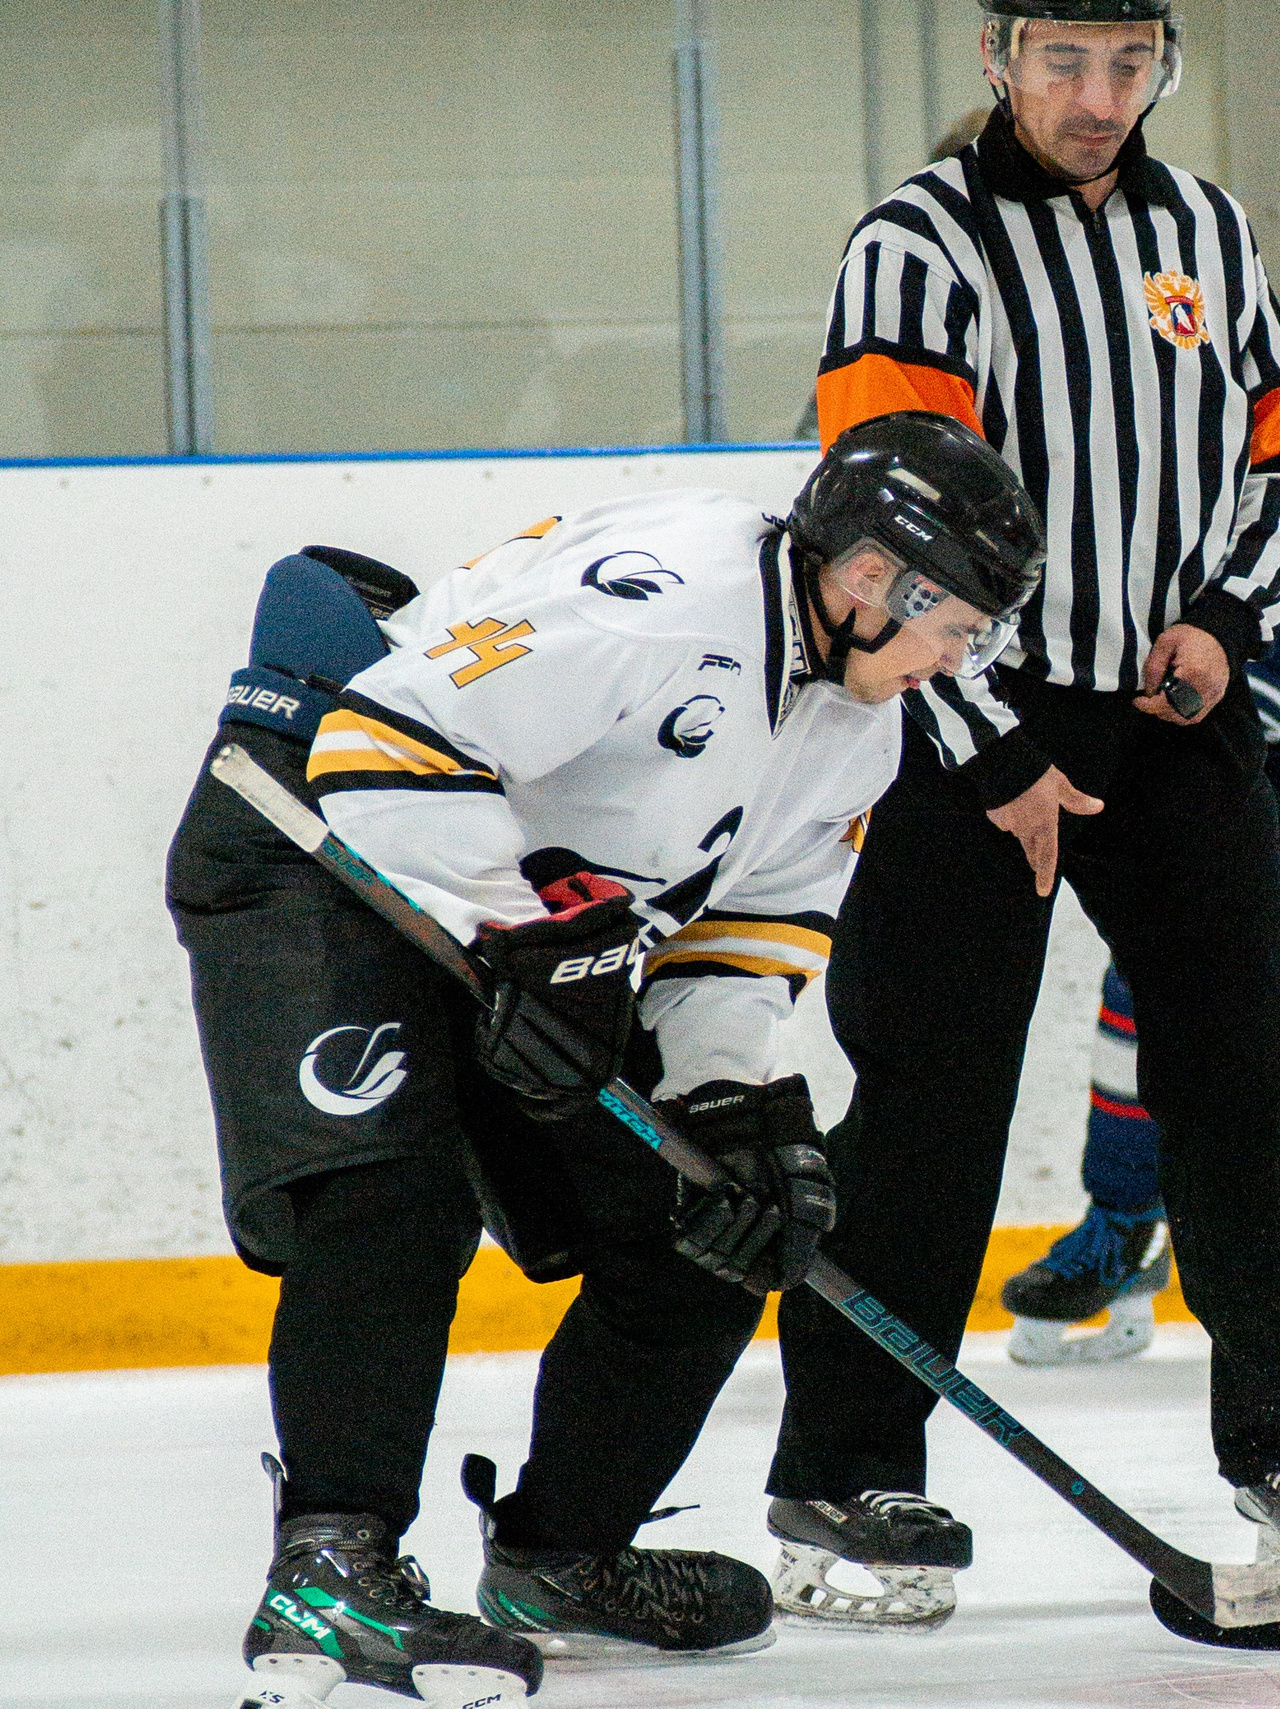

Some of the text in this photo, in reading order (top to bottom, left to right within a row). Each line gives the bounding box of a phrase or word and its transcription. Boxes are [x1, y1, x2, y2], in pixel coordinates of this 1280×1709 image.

[894, 514, 933, 542] CCM
[689, 1094, 746, 1114] BAUER
[841, 1289, 1028, 1447] BAUER
[462, 1693, 502, 1709] CCM
